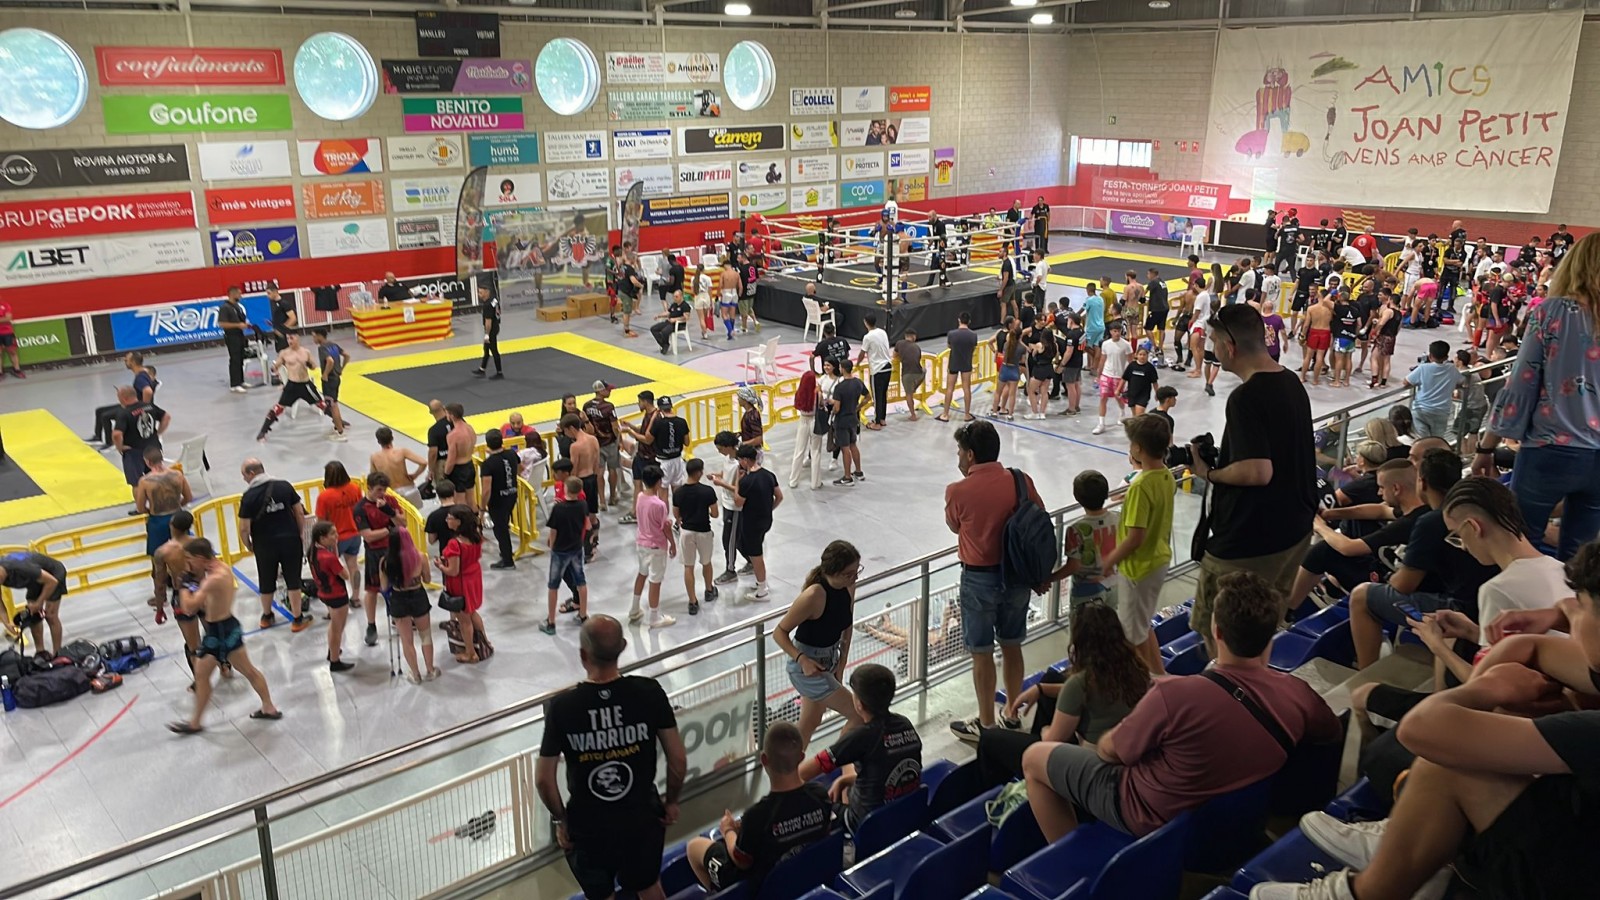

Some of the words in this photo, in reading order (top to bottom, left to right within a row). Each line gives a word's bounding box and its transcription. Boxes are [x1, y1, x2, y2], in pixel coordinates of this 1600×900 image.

[1354, 62, 1491, 97] AMICS
[436, 99, 490, 114] BENITO
[803, 95, 835, 105] COLLELL
[149, 102, 258, 126] Goufone
[431, 114, 499, 129] NOVATILU
[1351, 105, 1442, 143] JOAN
[1458, 109, 1559, 143] PETIT
[617, 140, 637, 149] BAXI
[714, 131, 762, 145] carrera
[323, 152, 360, 162] TRIOLA
[490, 144, 519, 157] humà
[1408, 152, 1447, 167] AMB
[1455, 144, 1554, 170] CÀNCER
[73, 156, 116, 168] ROVIRA
[117, 153, 157, 165] MOTOR
[158, 152, 177, 164] S.A.
[855, 161, 879, 169] PROTECTA
[891, 156, 900, 166] SP
[422, 187, 450, 195] FEIXAS
[851, 184, 874, 196] coro
[1168, 182, 1193, 194] JOAN
[1195, 185, 1219, 196] PETIT
[136, 201, 181, 211] Innovation
[221, 199, 247, 211] més
[249, 198, 292, 210] viatges
[7, 246, 90, 272] ALBET
[593, 302, 597, 313] 1
[561, 311, 568, 321] 3
[587, 705, 624, 731] THE
[566, 722, 650, 752] WARRIOR
